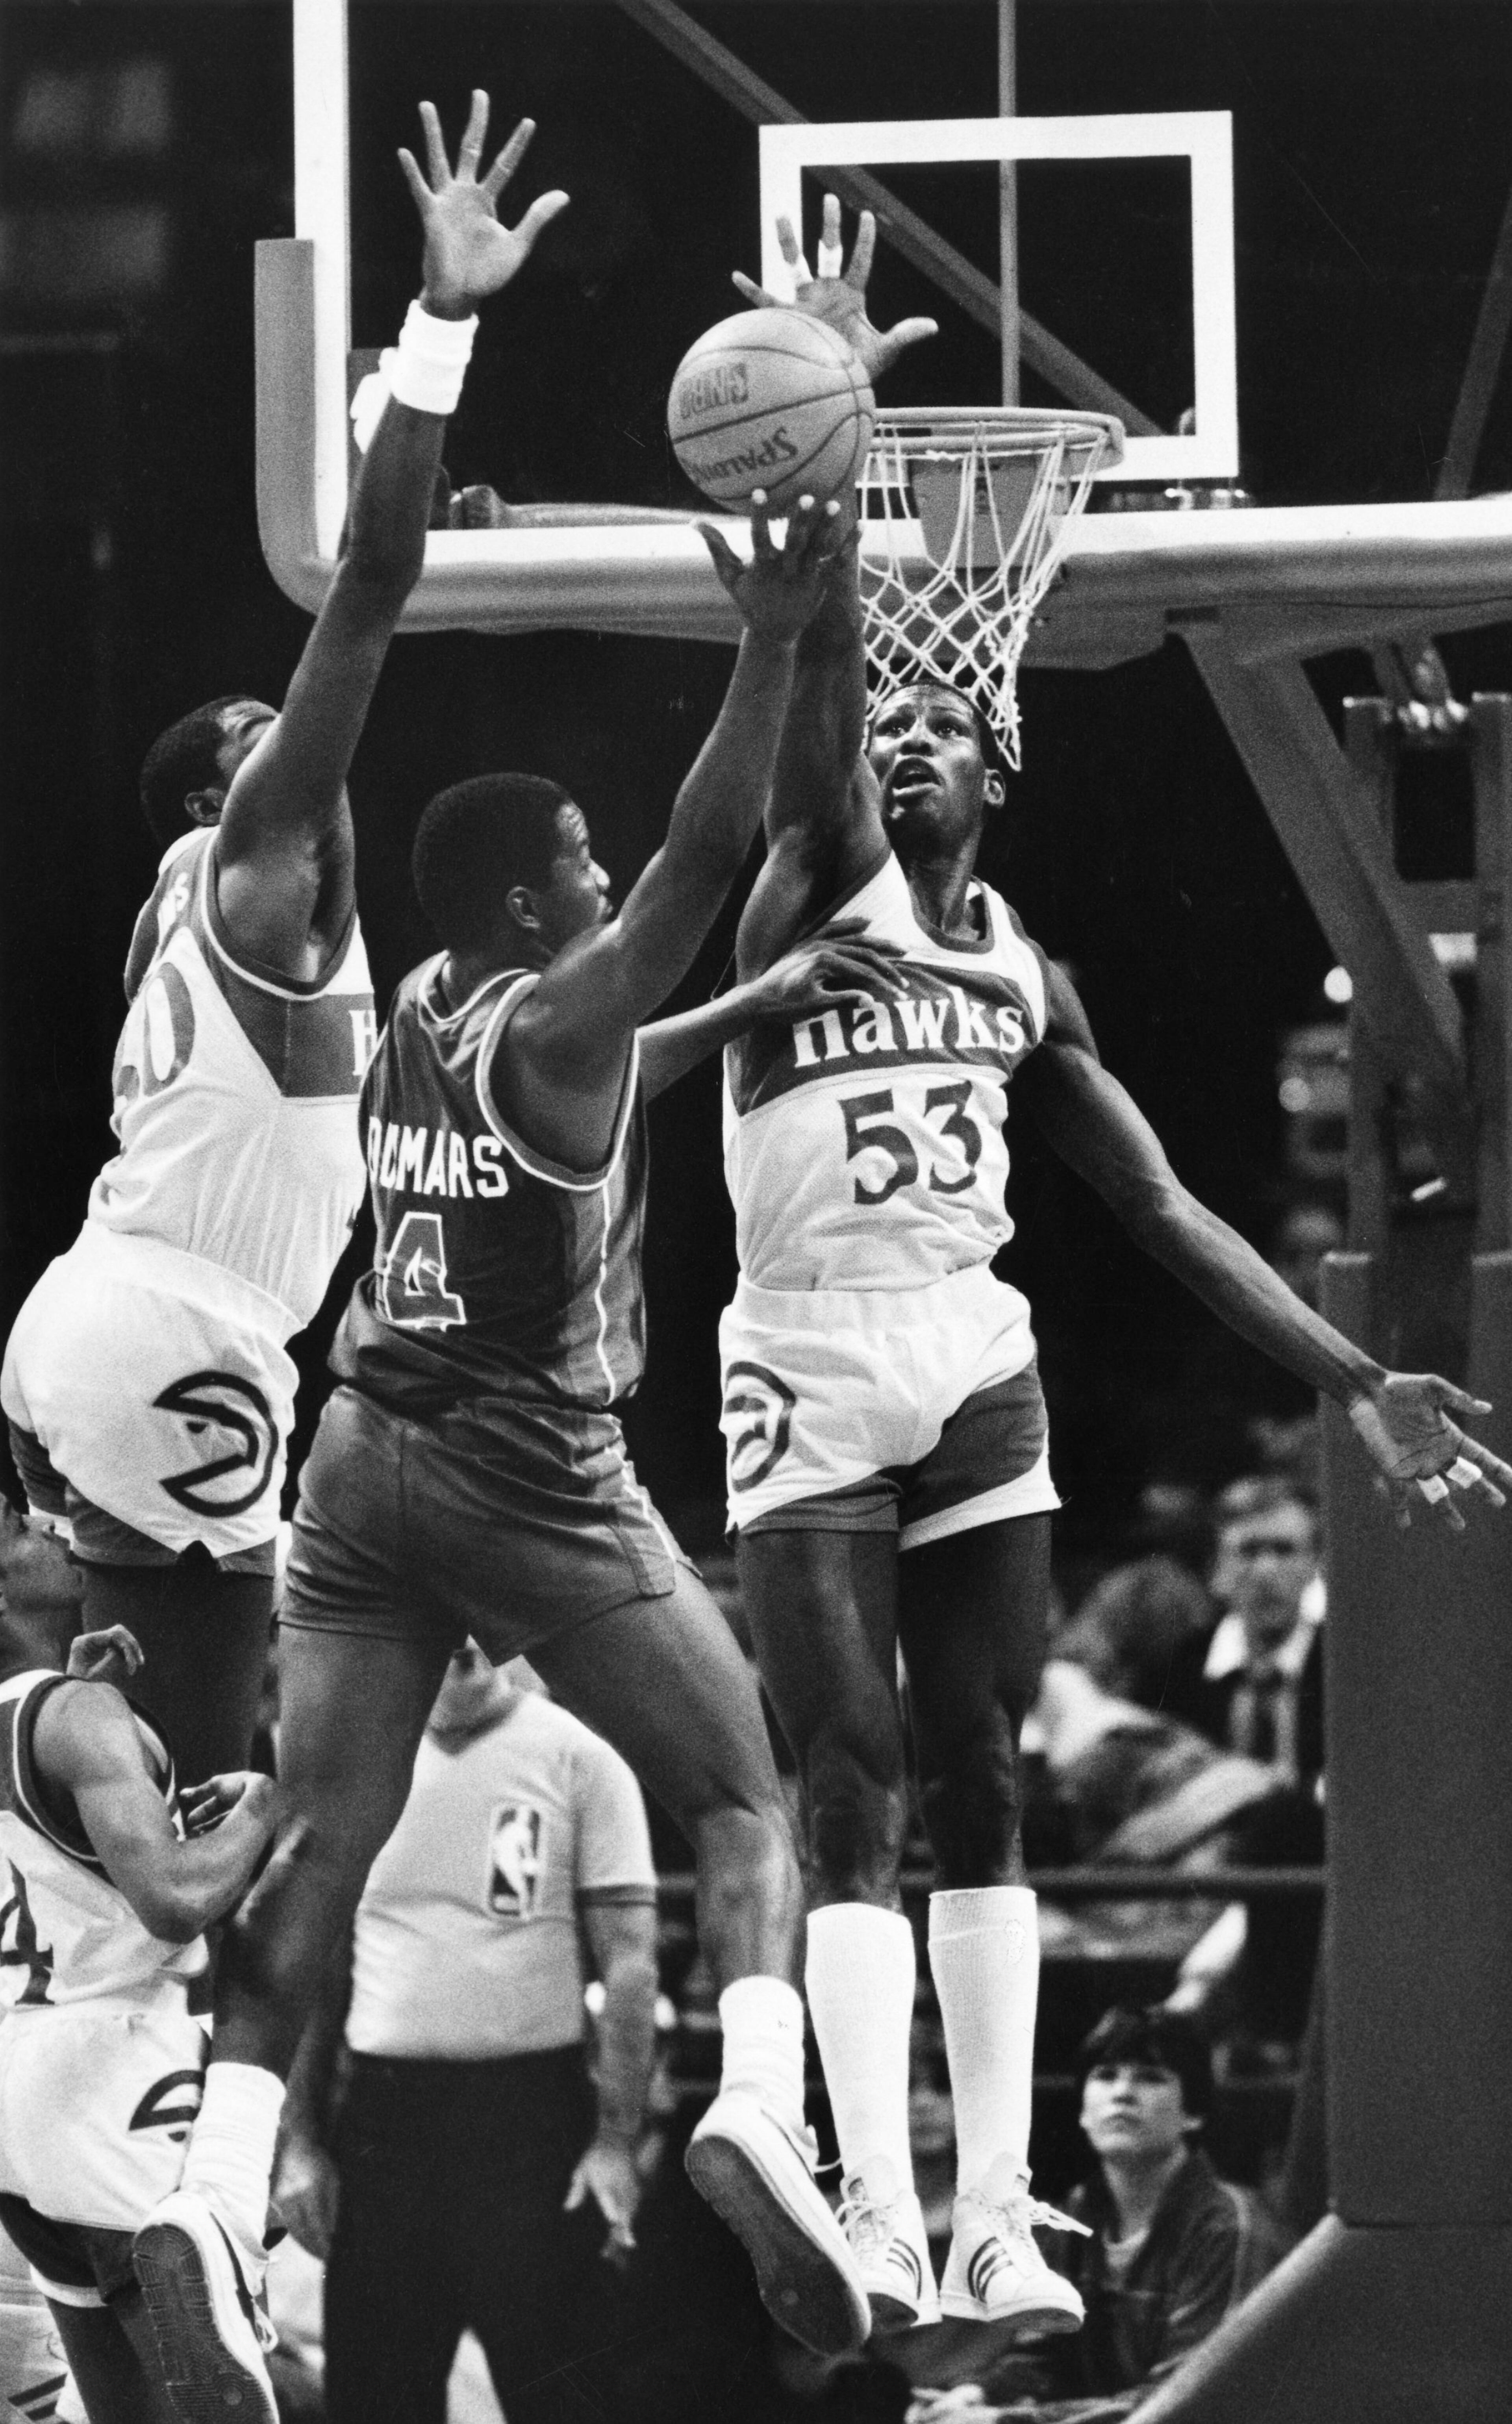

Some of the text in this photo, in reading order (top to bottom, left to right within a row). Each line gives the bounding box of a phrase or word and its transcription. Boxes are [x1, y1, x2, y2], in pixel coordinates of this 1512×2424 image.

[116, 962, 196, 1101] 0
[367, 1115, 509, 1197] DUMARS
[838, 1080, 982, 1205] 53
[382, 1210, 467, 1326] 4
